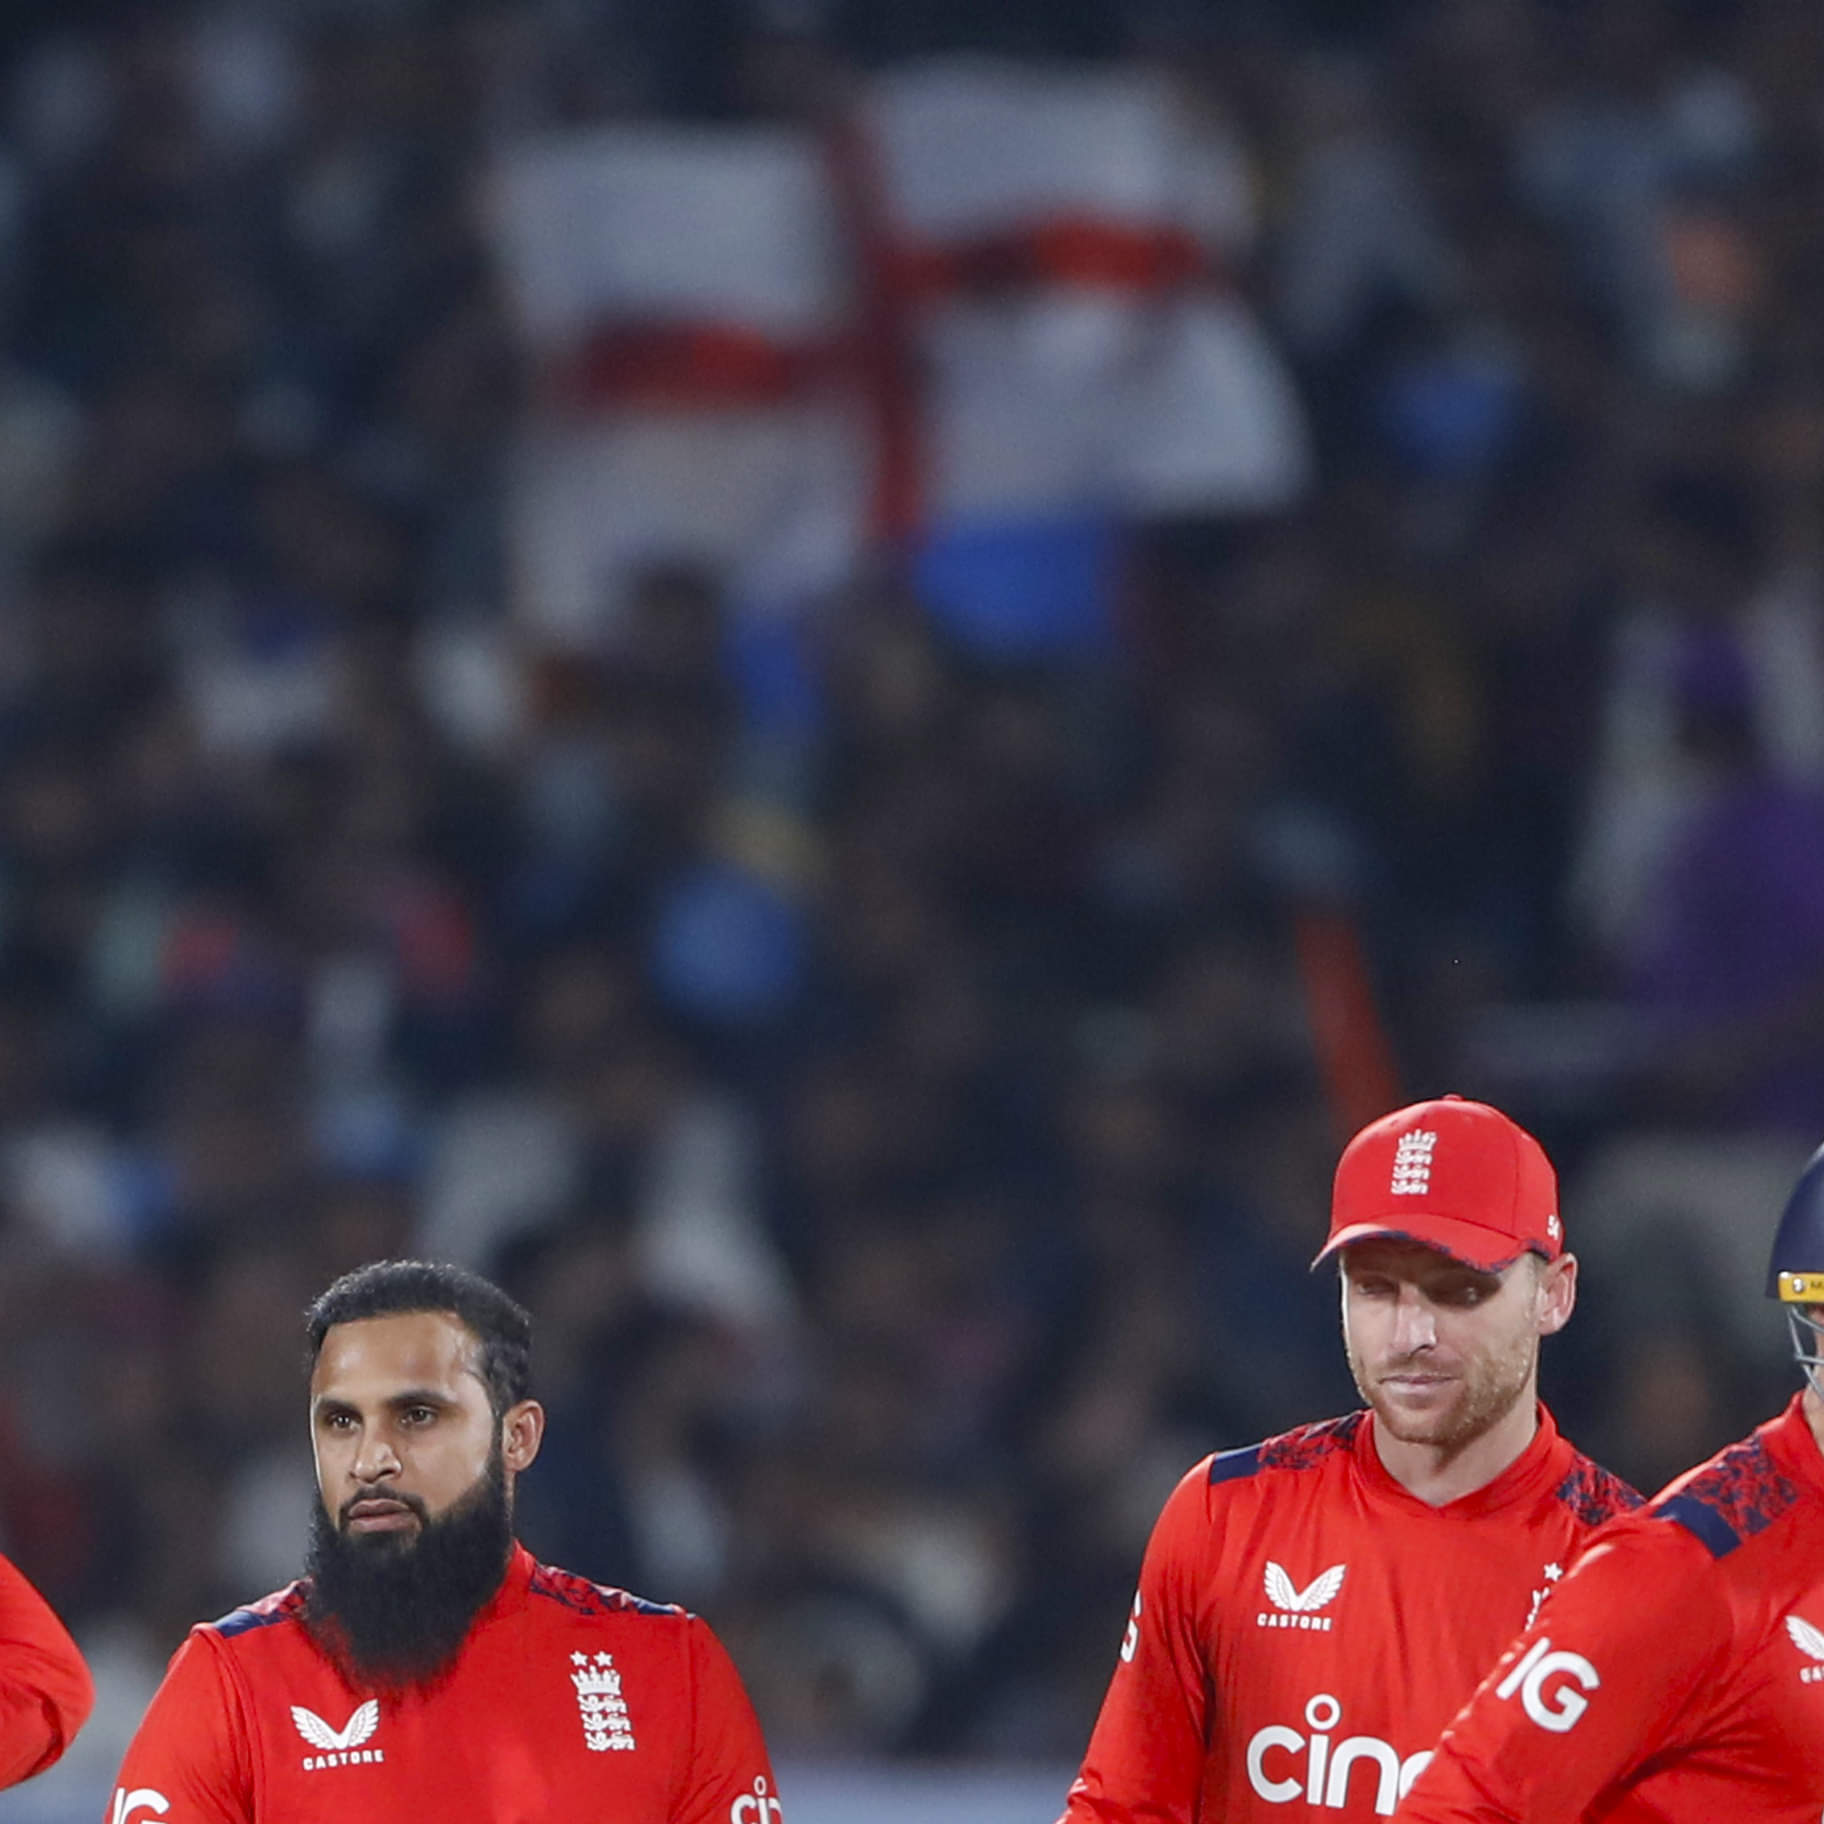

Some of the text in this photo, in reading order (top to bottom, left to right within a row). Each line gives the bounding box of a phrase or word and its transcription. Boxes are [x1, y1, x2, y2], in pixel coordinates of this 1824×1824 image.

[1257, 1612, 1332, 1631] CASTORE
[1496, 1636, 1600, 1732] IG
[302, 1748, 385, 1771] CASTORE
